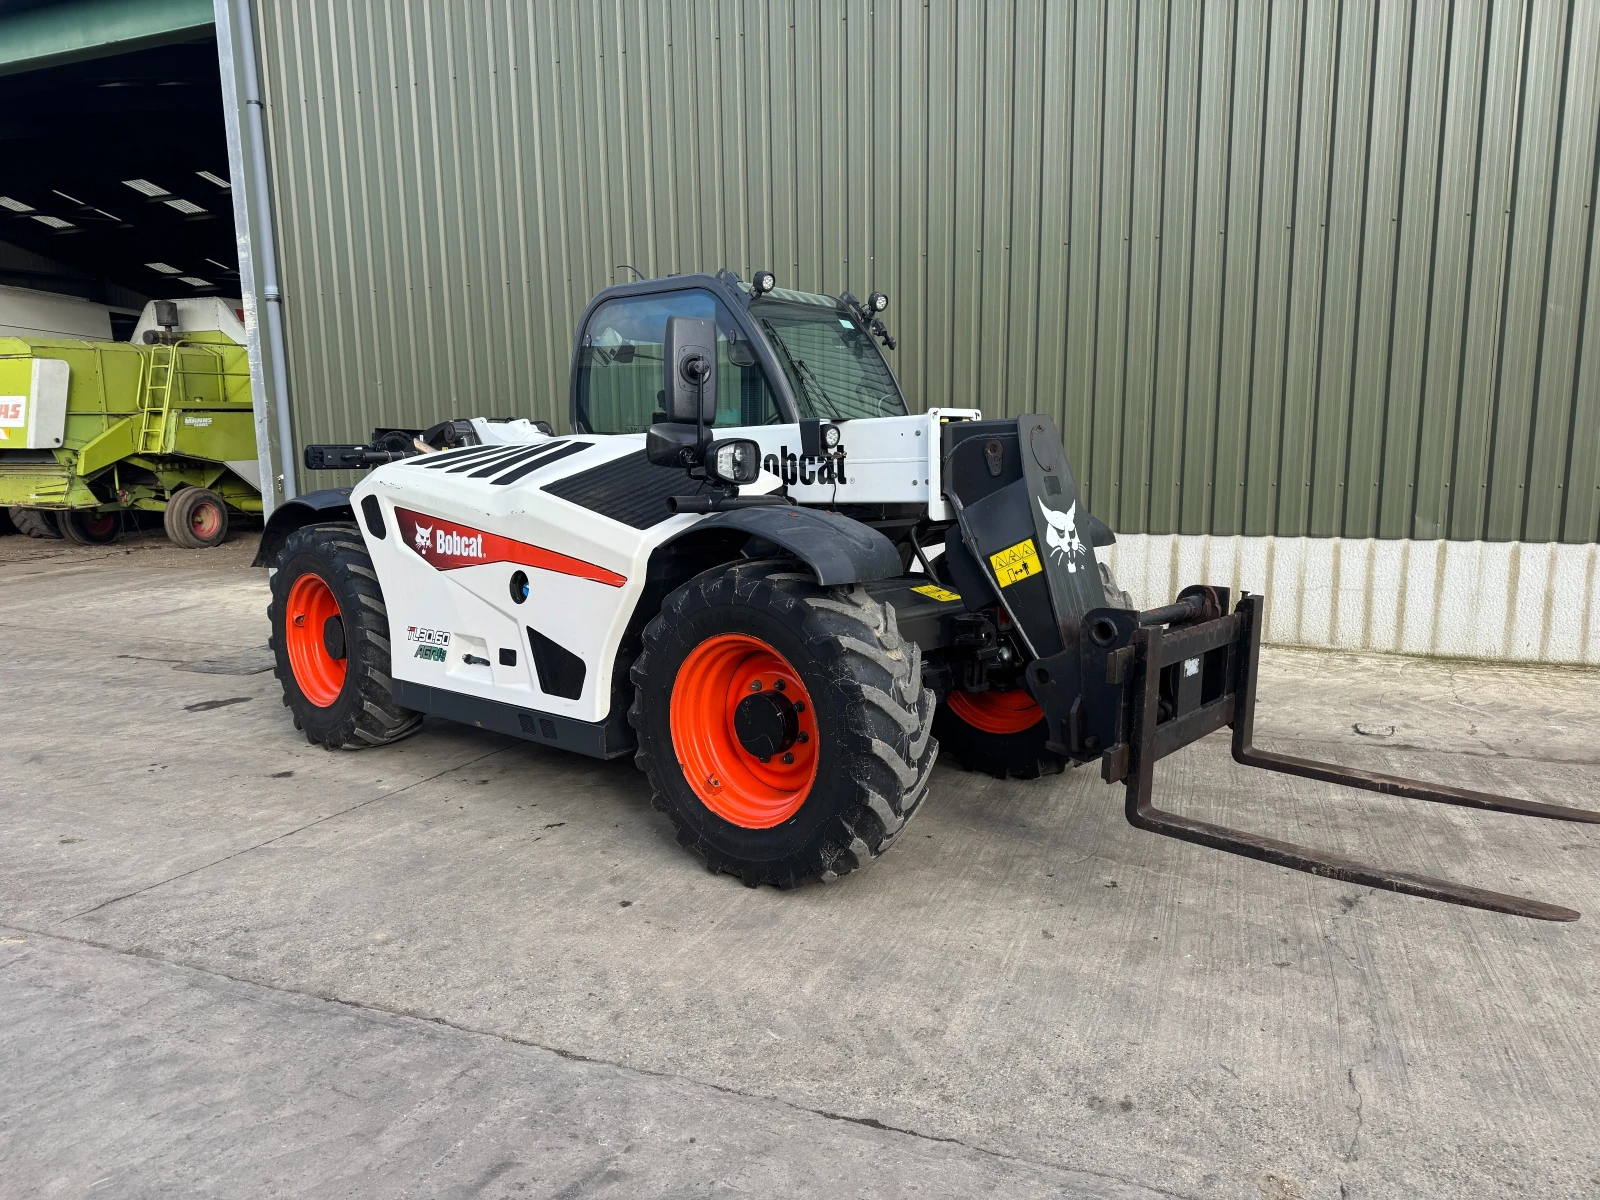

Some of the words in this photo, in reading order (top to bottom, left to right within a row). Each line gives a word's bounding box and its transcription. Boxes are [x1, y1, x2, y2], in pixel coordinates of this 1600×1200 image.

[763, 445, 847, 486] obcat
[436, 529, 483, 558] Bobcat
[407, 626, 451, 646] TL30.60
